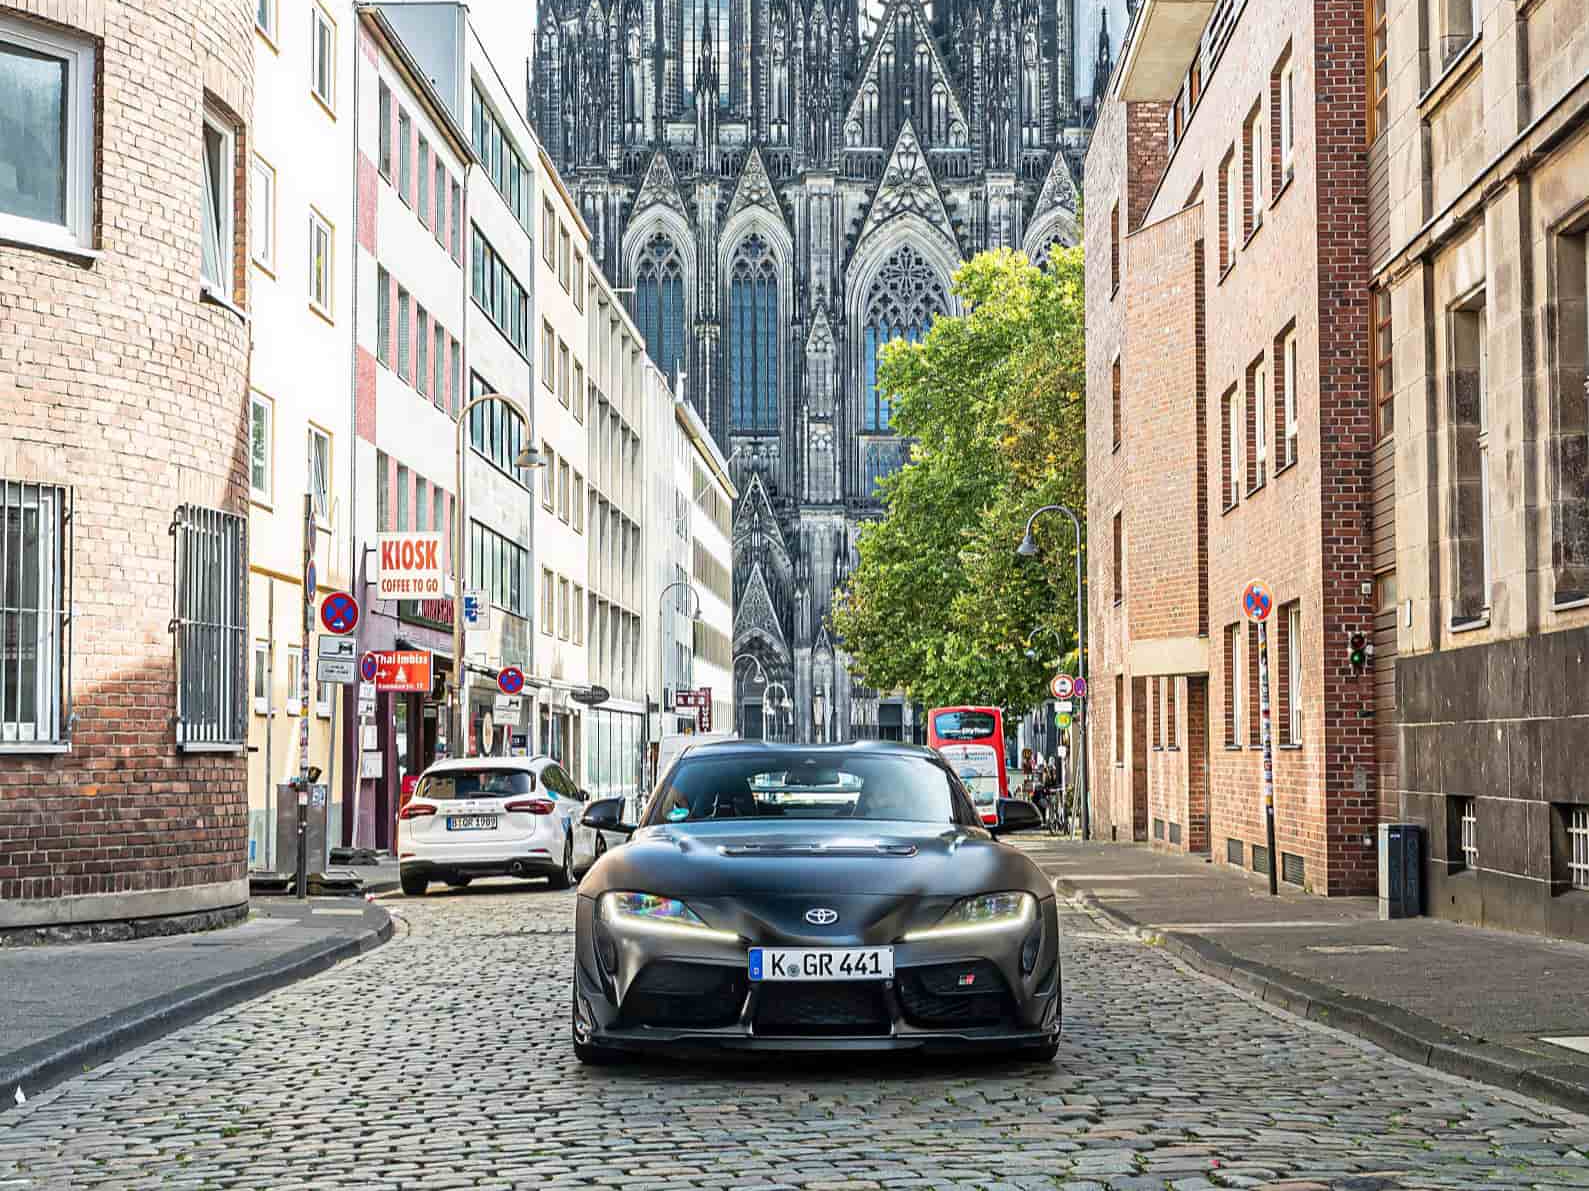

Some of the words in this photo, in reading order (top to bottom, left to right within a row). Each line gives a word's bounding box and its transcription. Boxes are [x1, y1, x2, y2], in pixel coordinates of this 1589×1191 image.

[382, 539, 438, 570] KIOSK
[382, 578, 410, 592] COFFEE
[413, 578, 424, 592] TO
[426, 578, 438, 592] GO
[375, 653, 396, 665] Thai
[771, 953, 786, 976] K
[803, 952, 833, 976] GR
[839, 952, 882, 975] 441
